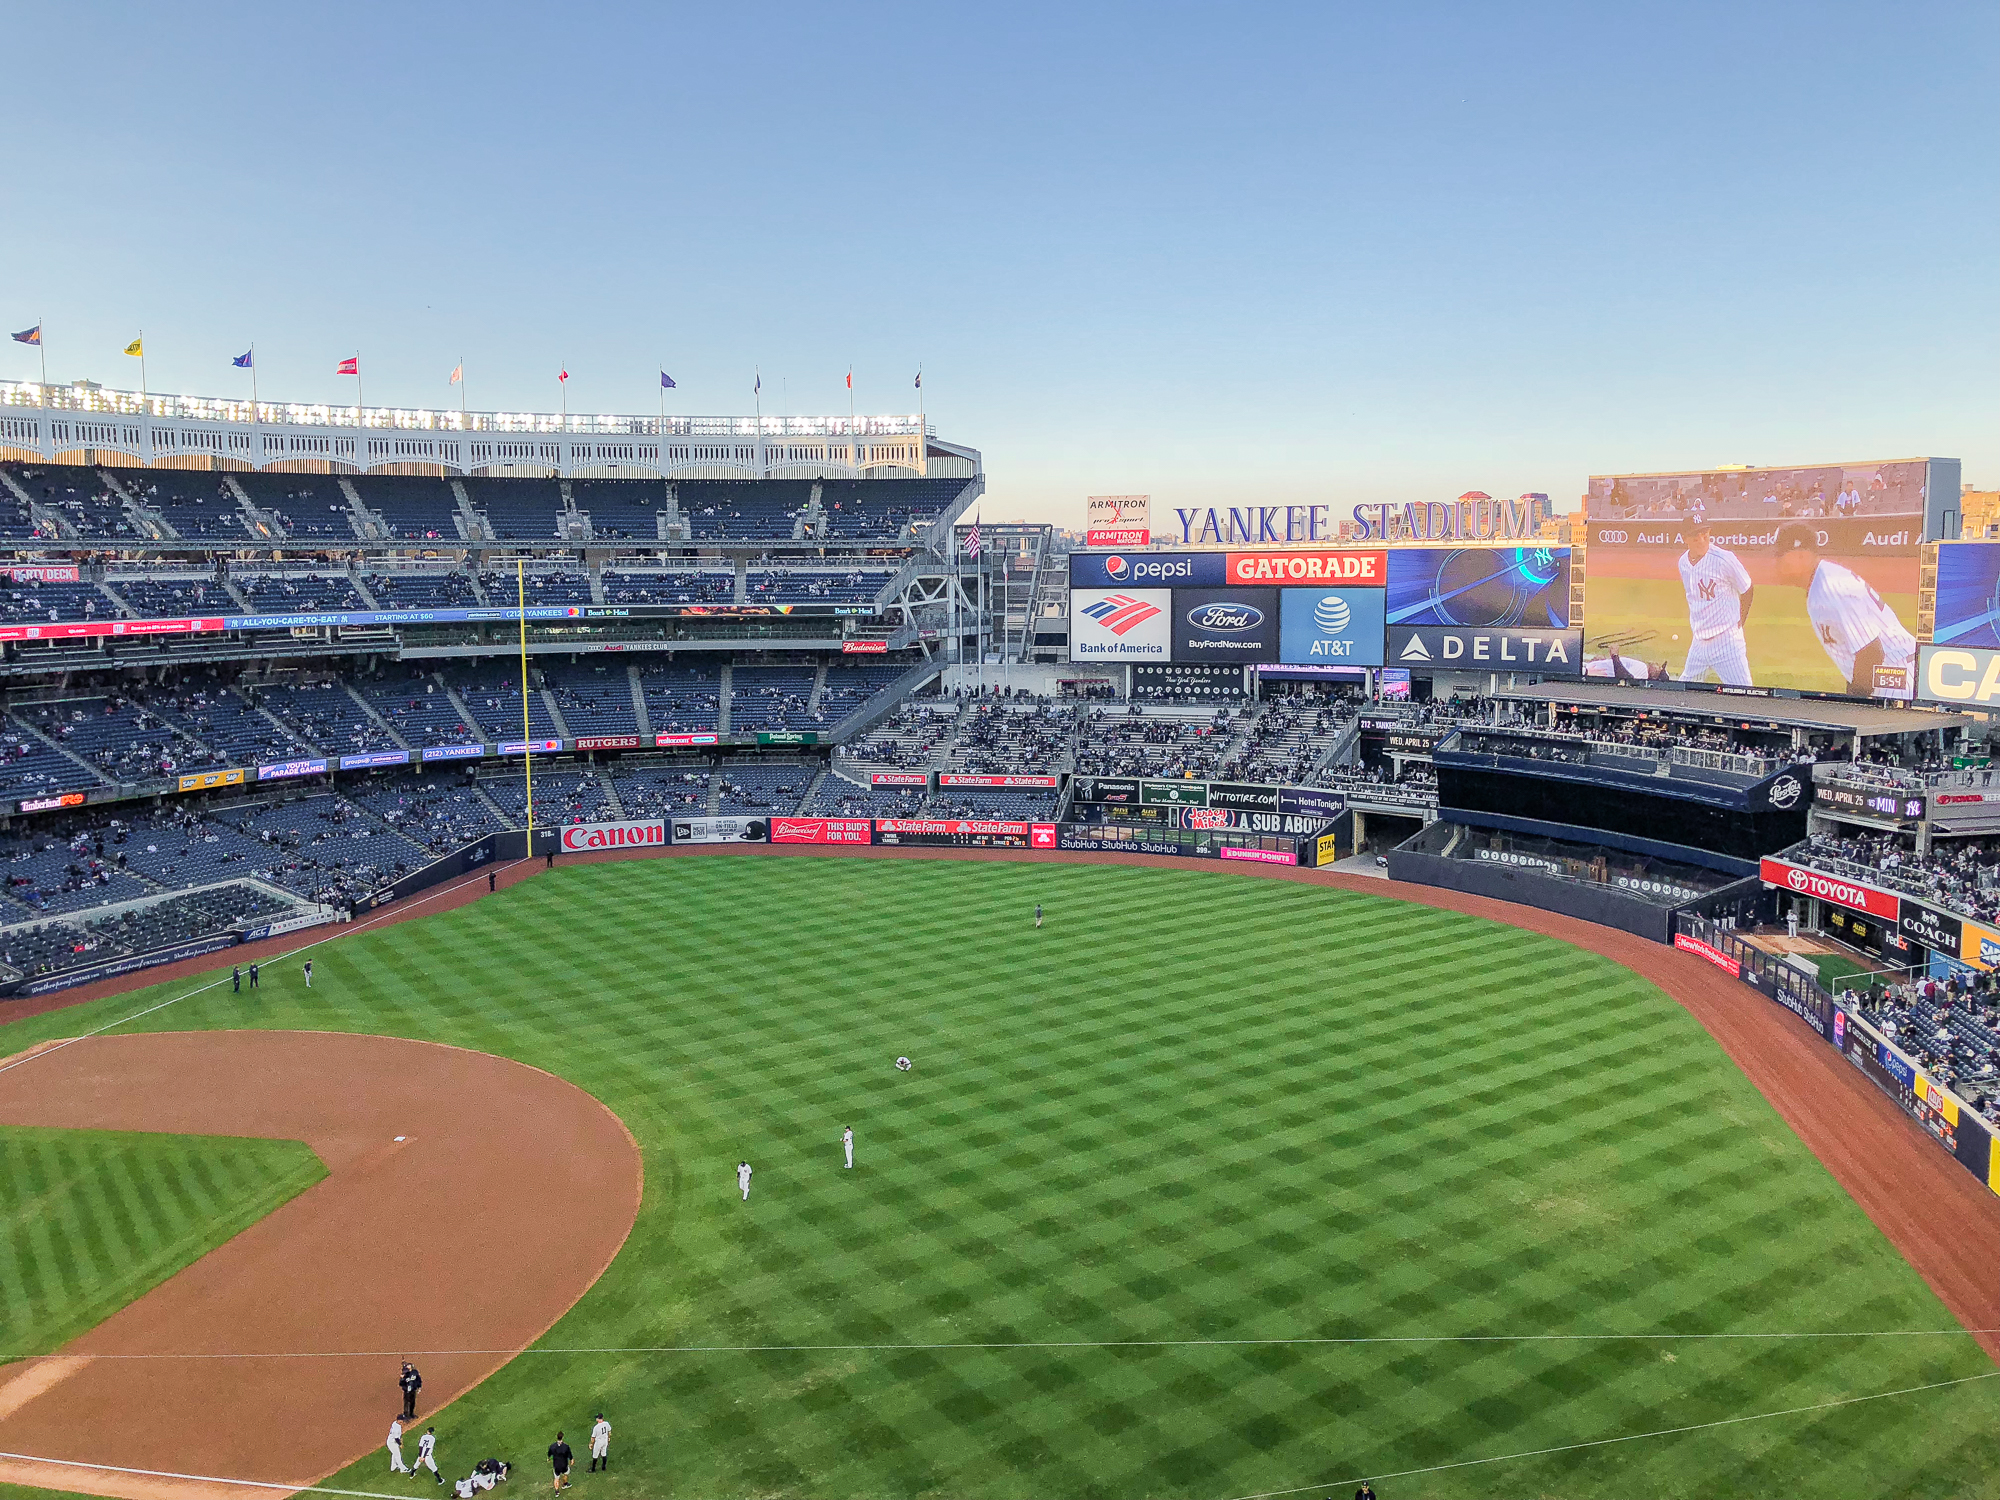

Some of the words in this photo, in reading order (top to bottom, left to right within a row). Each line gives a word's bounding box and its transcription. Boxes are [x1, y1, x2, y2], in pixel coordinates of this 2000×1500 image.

[1089, 500, 1147, 509] ARMITRON
[1173, 505, 1329, 544] YANKEE
[1352, 499, 1536, 543] STADIUM
[1092, 532, 1144, 540] ARMITRON
[1637, 531, 1670, 544] Audi
[1863, 529, 1910, 546] Audi
[46, 568, 74, 580] DECK
[1133, 558, 1193, 586] pepsi
[1236, 558, 1377, 580] GATORADE
[374, 613, 409, 621] STARTING
[421, 612, 434, 620] $60
[506, 610, 525, 618] (212)
[527, 609, 562, 617] YANKEES
[858, 607, 873, 615] Head
[1202, 606, 1248, 628] Ford
[242, 615, 338, 627] ALL-YOU-CARE-TO-EAT
[626, 643, 652, 651] YANKEES
[843, 641, 886, 652] Budweiser
[1080, 642, 1106, 653] Bank
[1106, 641, 1120, 654] of
[1119, 642, 1163, 654] America
[1188, 640, 1262, 651] BuyFordNow.com
[1310, 640, 1355, 657] AT&T
[1442, 635, 1569, 664] DELTA
[1875, 667, 1906, 677] ARMITRON
[1879, 676, 1901, 687] 6:54
[1361, 720, 1371, 729] 212
[577, 737, 637, 749] RUTGERS
[658, 737, 691, 746] realtor.com
[769, 732, 785, 741] Poland
[786, 732, 804, 742] Spring
[1404, 737, 1421, 747] APRIL
[1422, 739, 1430, 748] 25
[424, 748, 443, 758] (212)
[445, 746, 481, 756] YANKEES
[285, 760, 311, 770] YOUTH
[345, 757, 371, 767] groups@
[271, 767, 299, 777] PARADE
[300, 765, 325, 775] GAMES
[1097, 782, 1135, 791] Panasonic
[21, 797, 61, 812] Timberland
[60, 793, 85, 807] PRO
[1209, 790, 1278, 807] NITTOTIRE.COM
[1834, 791, 1854, 806] APRIL
[1854, 795, 1864, 807] 25
[1875, 797, 1896, 815] MIN
[1189, 807, 1227, 821] Jersey
[827, 821, 846, 832] THIS
[847, 822, 870, 833] BUD'S
[1191, 818, 1228, 830] Mike's
[1240, 813, 1252, 829] A
[1253, 814, 1281, 832] SUB
[1284, 816, 1330, 834] ABOV
[779, 823, 819, 838] Budweiser
[562, 824, 664, 850] Canon
[827, 831, 844, 842] FOR
[844, 832, 863, 843] YOU.
[1060, 839, 1098, 850] StubHub
[1101, 840, 1138, 852] StubHub
[1138, 842, 1177, 855] StubHub
[1232, 849, 1262, 858] DUNKIN'
[1262, 852, 1290, 862] DONUTS
[1809, 876, 1867, 908] TOYOTA
[249, 927, 269, 938] ACC
[1903, 917, 1957, 949] COACH
[1886, 930, 1908, 951] FedEx
[1776, 988, 1804, 1016] StubHub
[1803, 1006, 1825, 1035] StubHub
[1890, 1059, 1909, 1078] pepsi
